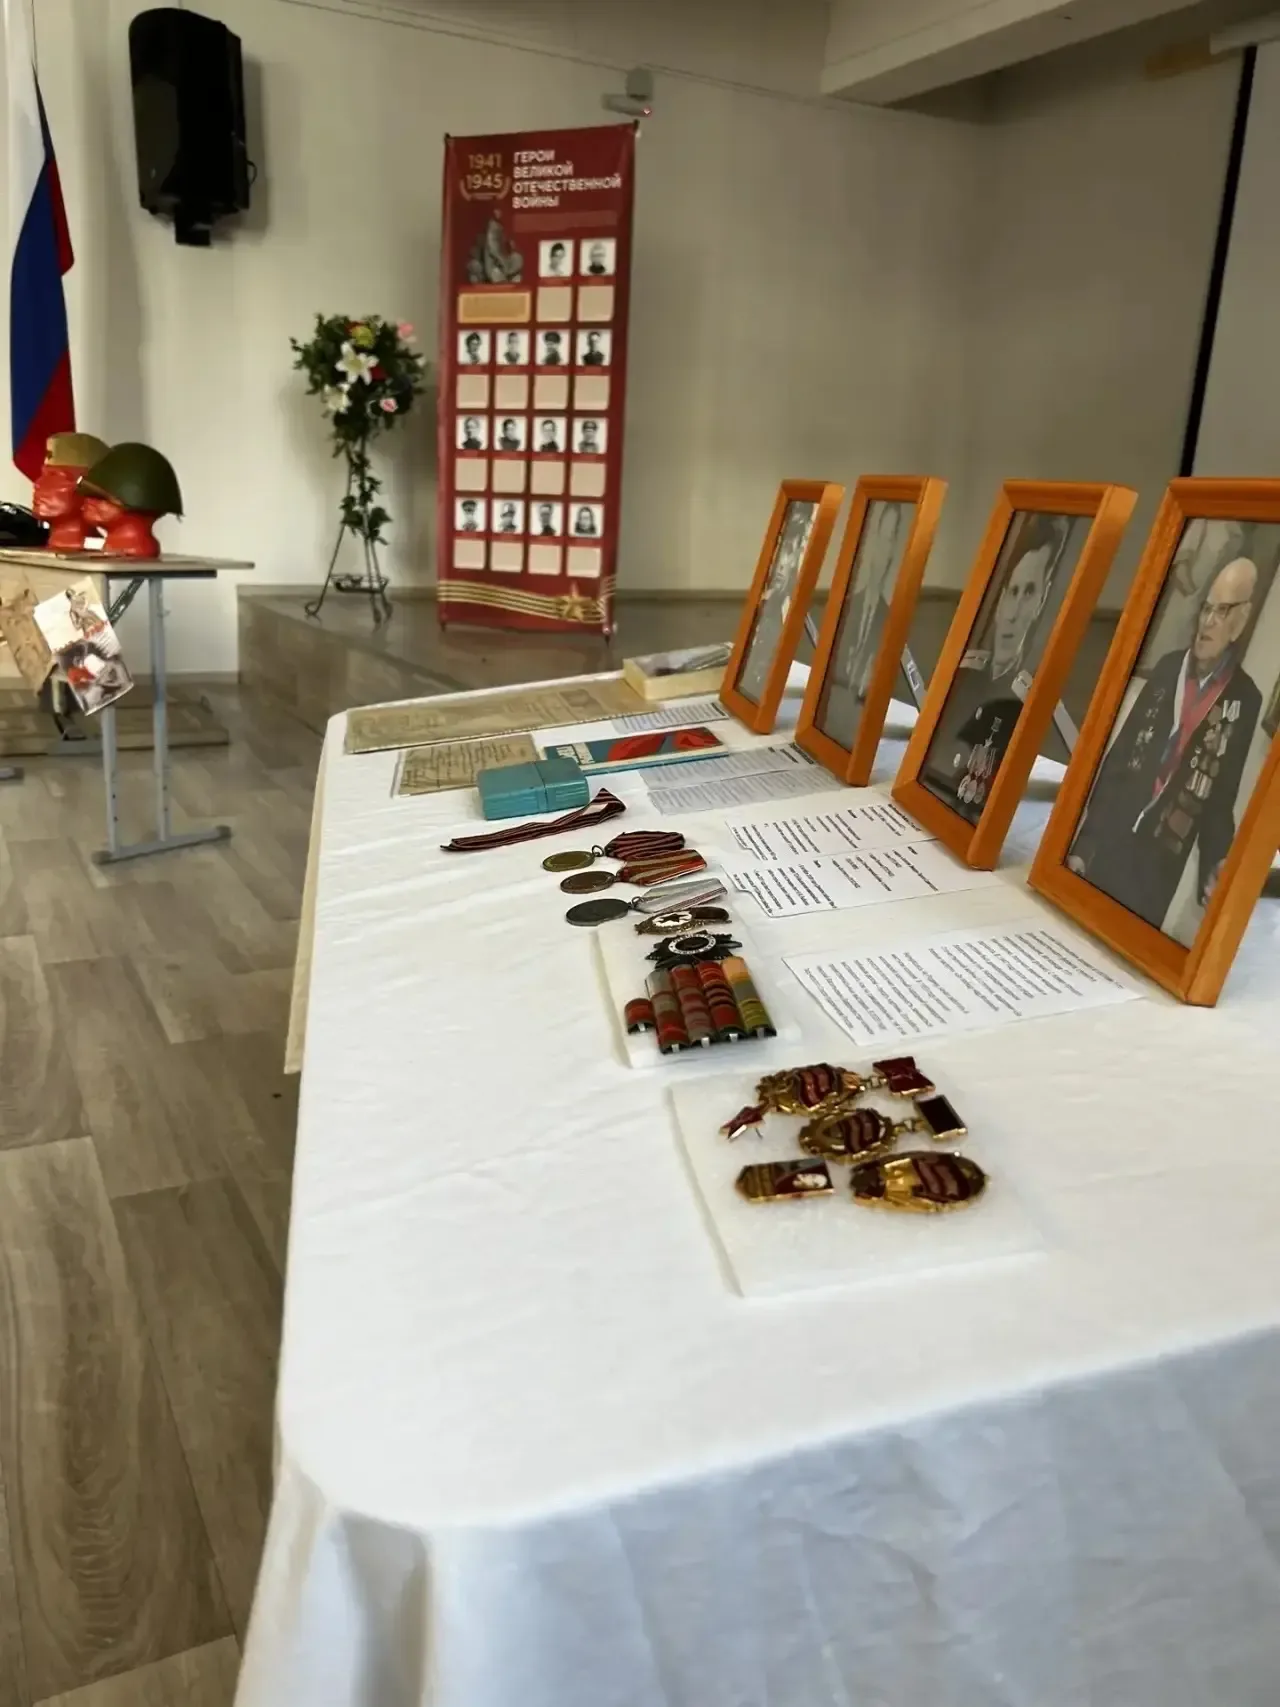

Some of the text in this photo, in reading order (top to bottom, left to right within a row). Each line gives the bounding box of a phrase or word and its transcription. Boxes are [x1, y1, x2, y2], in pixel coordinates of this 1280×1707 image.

[468, 153, 502, 169] 1941
[513, 149, 555, 164] ГЕРОИ
[513, 160, 574, 178] ВЕЛИКОЙ
[466, 173, 503, 189] 1945
[512, 172, 622, 194] ОТЕЧЕСТВЕННОЙ
[512, 194, 560, 209] ВОЙНЫ
